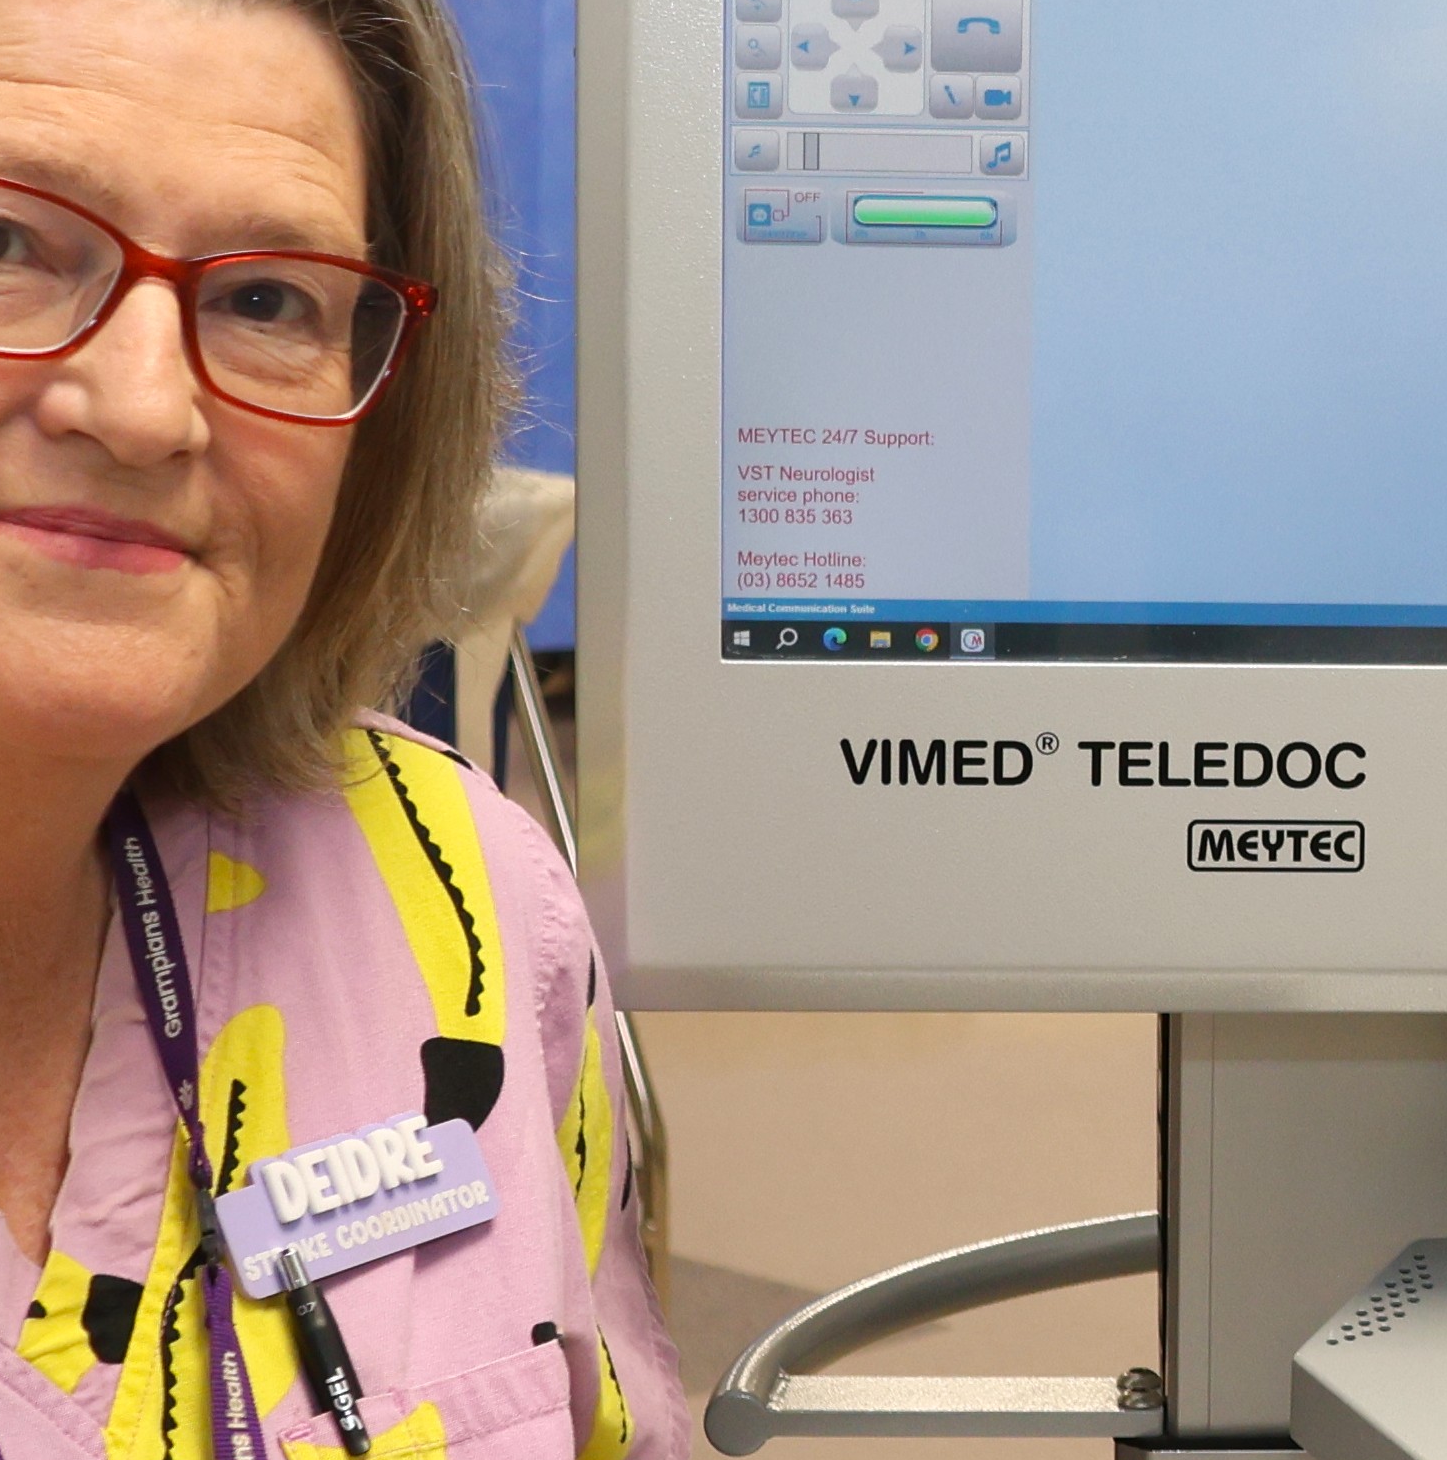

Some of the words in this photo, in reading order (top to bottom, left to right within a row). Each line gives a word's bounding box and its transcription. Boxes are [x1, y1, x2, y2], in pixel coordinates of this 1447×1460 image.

[794, 191, 822, 205] OFF
[737, 428, 817, 444] MEYTEC
[821, 429, 858, 445] 24/7
[864, 430, 935, 448] Support:
[737, 465, 775, 481] VST
[779, 466, 875, 486] Neurologist
[737, 487, 797, 503] service
[802, 489, 860, 506] phone:
[738, 508, 779, 524] 1300
[784, 508, 816, 524] 835
[821, 509, 853, 525] 363
[737, 551, 799, 570] Meytec
[804, 551, 866, 568] Hotline:
[737, 572, 771, 590] (03)
[775, 573, 818, 588] 8652
[824, 573, 865, 589] 1485
[727, 603, 767, 614] Medical
[768, 603, 847, 615] Communication
[850, 604, 876, 615] Suite
[1078, 740, 1368, 790] TELEDOC
[1195, 828, 1357, 864] MEYTEC
[124, 836, 157, 910] Health
[136, 910, 183, 1039] Grampians
[261, 1114, 445, 1225] DEIDRE
[335, 1179, 490, 1251] COORDINATOR
[222, 1351, 249, 1436] Health
